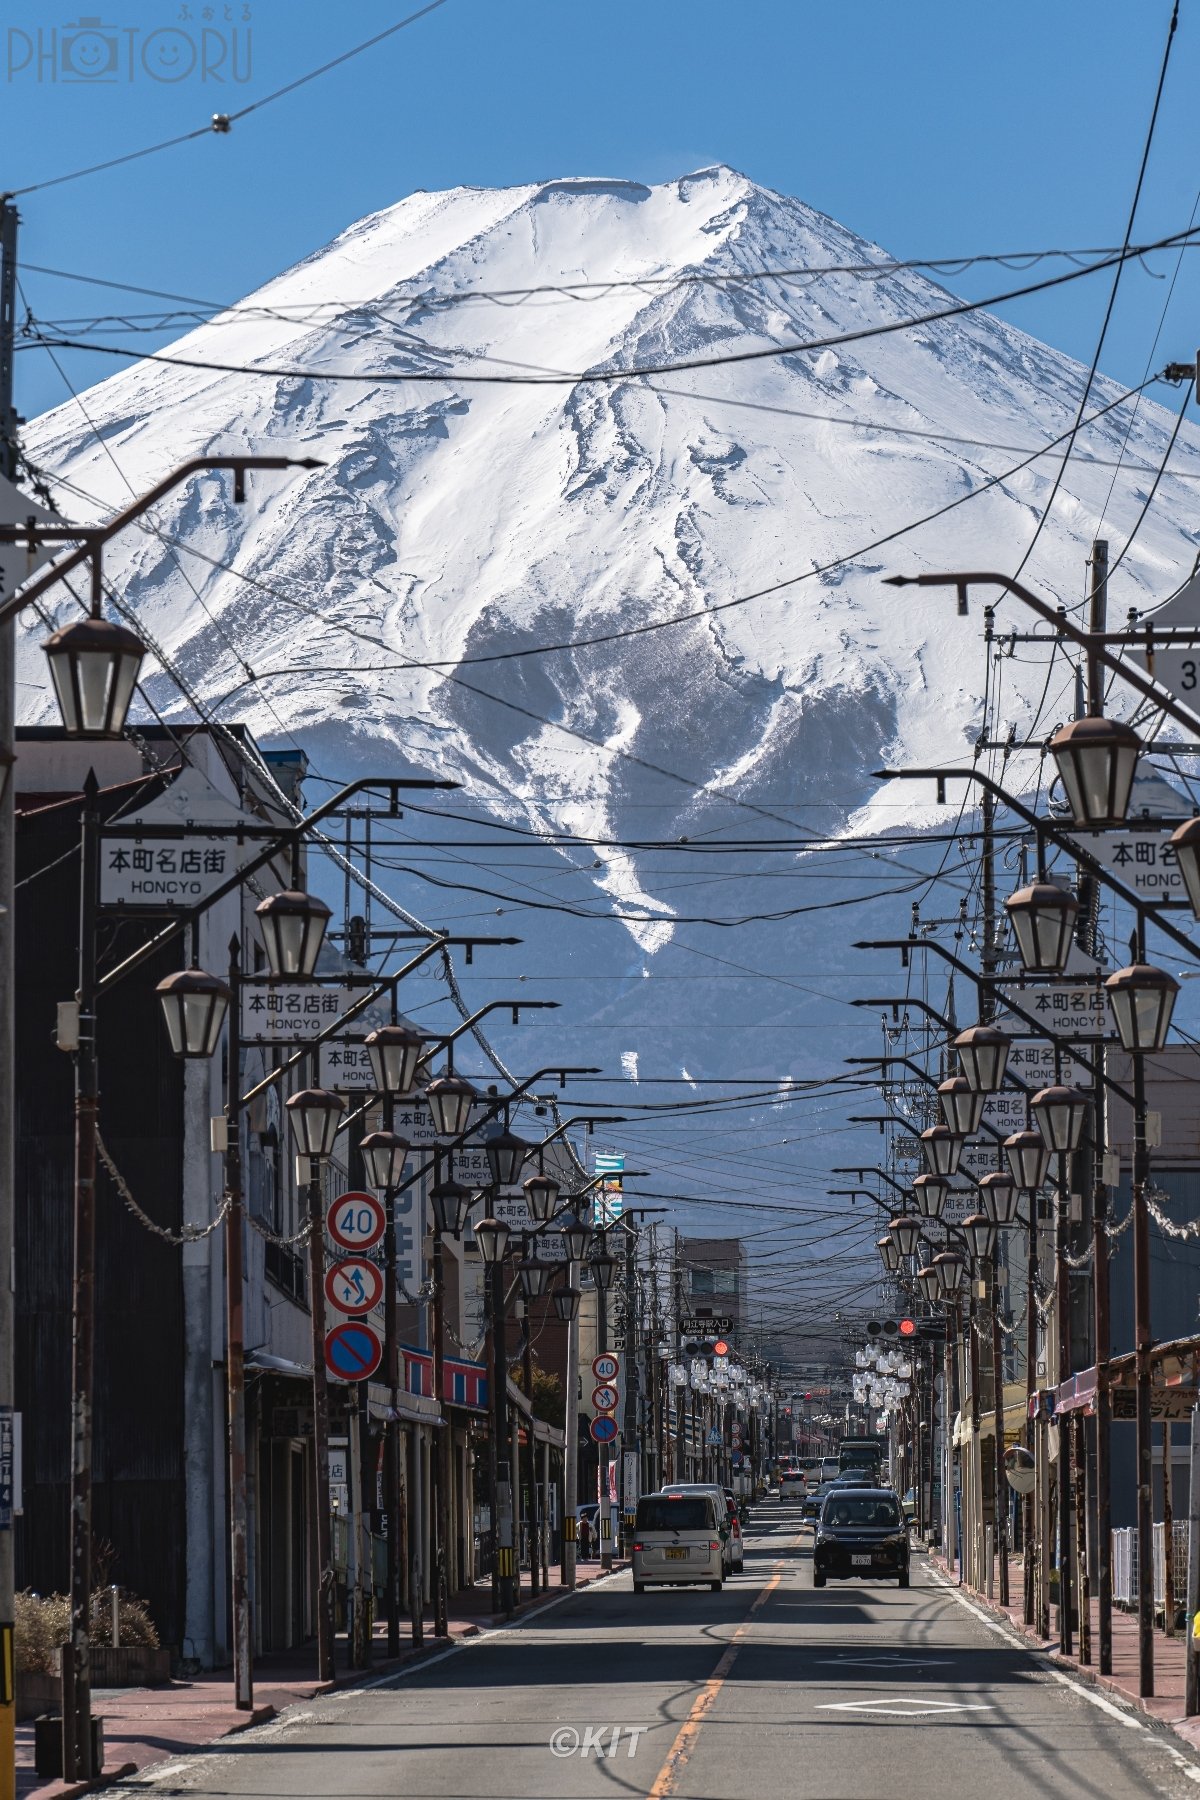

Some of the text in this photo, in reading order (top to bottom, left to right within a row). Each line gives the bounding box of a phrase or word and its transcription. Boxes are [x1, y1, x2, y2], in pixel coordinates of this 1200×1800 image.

[109, 847, 226, 874] 本町名店街
[248, 993, 339, 1014] 本町名店街
[340, 1208, 373, 1234] 40
[598, 1362, 614, 1375] 40
